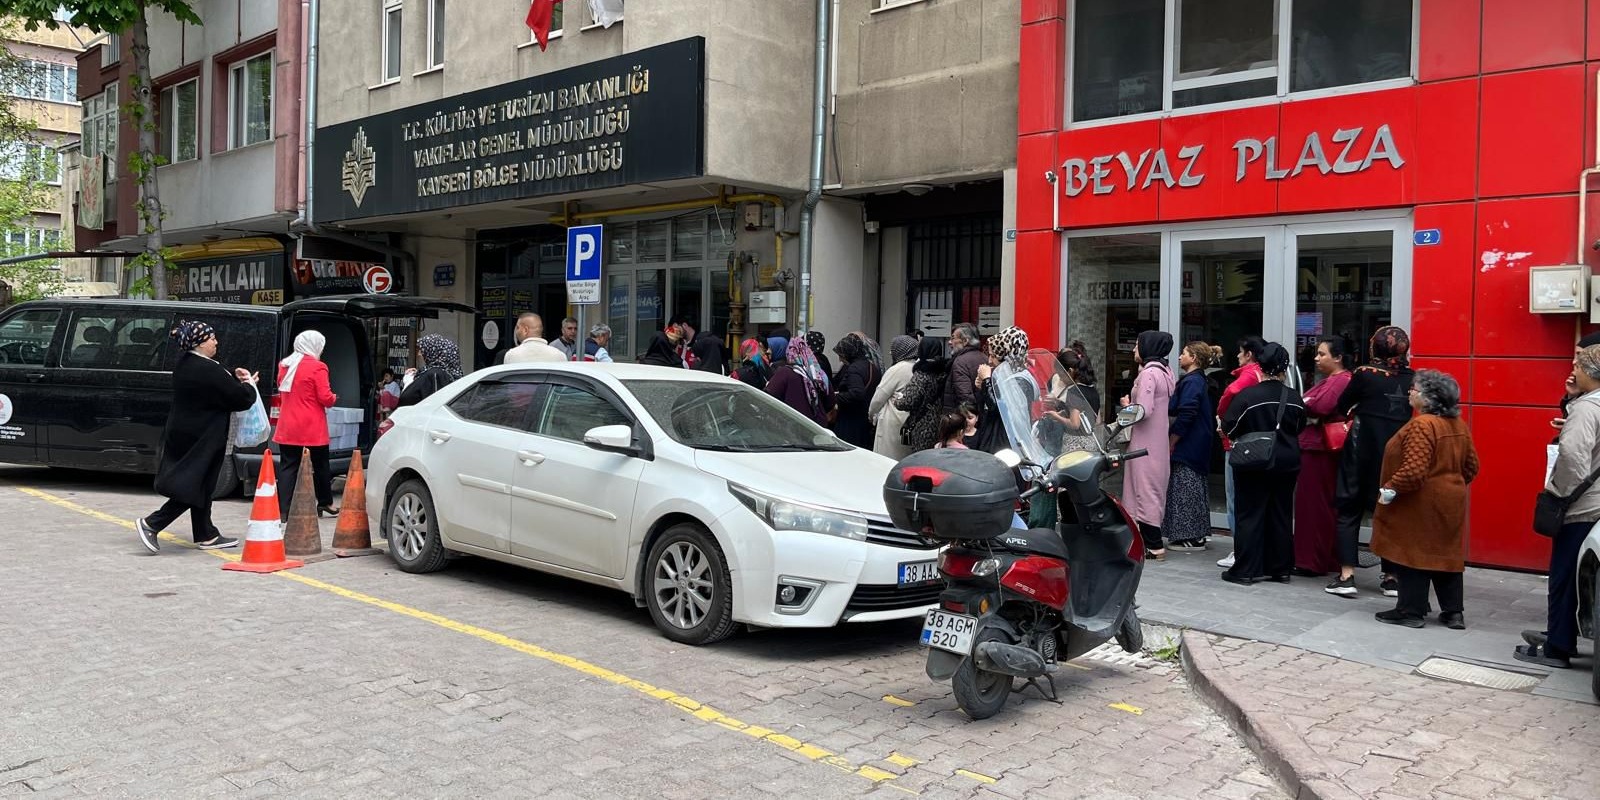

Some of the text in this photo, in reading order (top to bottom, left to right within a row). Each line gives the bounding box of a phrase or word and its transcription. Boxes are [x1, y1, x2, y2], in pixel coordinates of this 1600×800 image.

[402, 64, 649, 141] T.C. KÜLTÜR VE TURİZM BAKANLIĞI
[414, 104, 630, 168] VAKIFLAR GENEL MÜDÜRLÜĞÜ
[417, 141, 623, 197] KAYSERİ BÖLGE MÜDÜRLÜĞÜ
[1061, 123, 1406, 197] BEYAZ PLAZA
[1423, 232, 1431, 243] 2
[575, 234, 595, 276] P
[188, 261, 265, 293] REKLAM
[257, 291, 280, 304] KAŞE
[1005, 537, 1028, 546] APEC
[906, 565, 918, 583] 38
[927, 612, 974, 636] 38 AGM
[932, 630, 958, 648] 520
